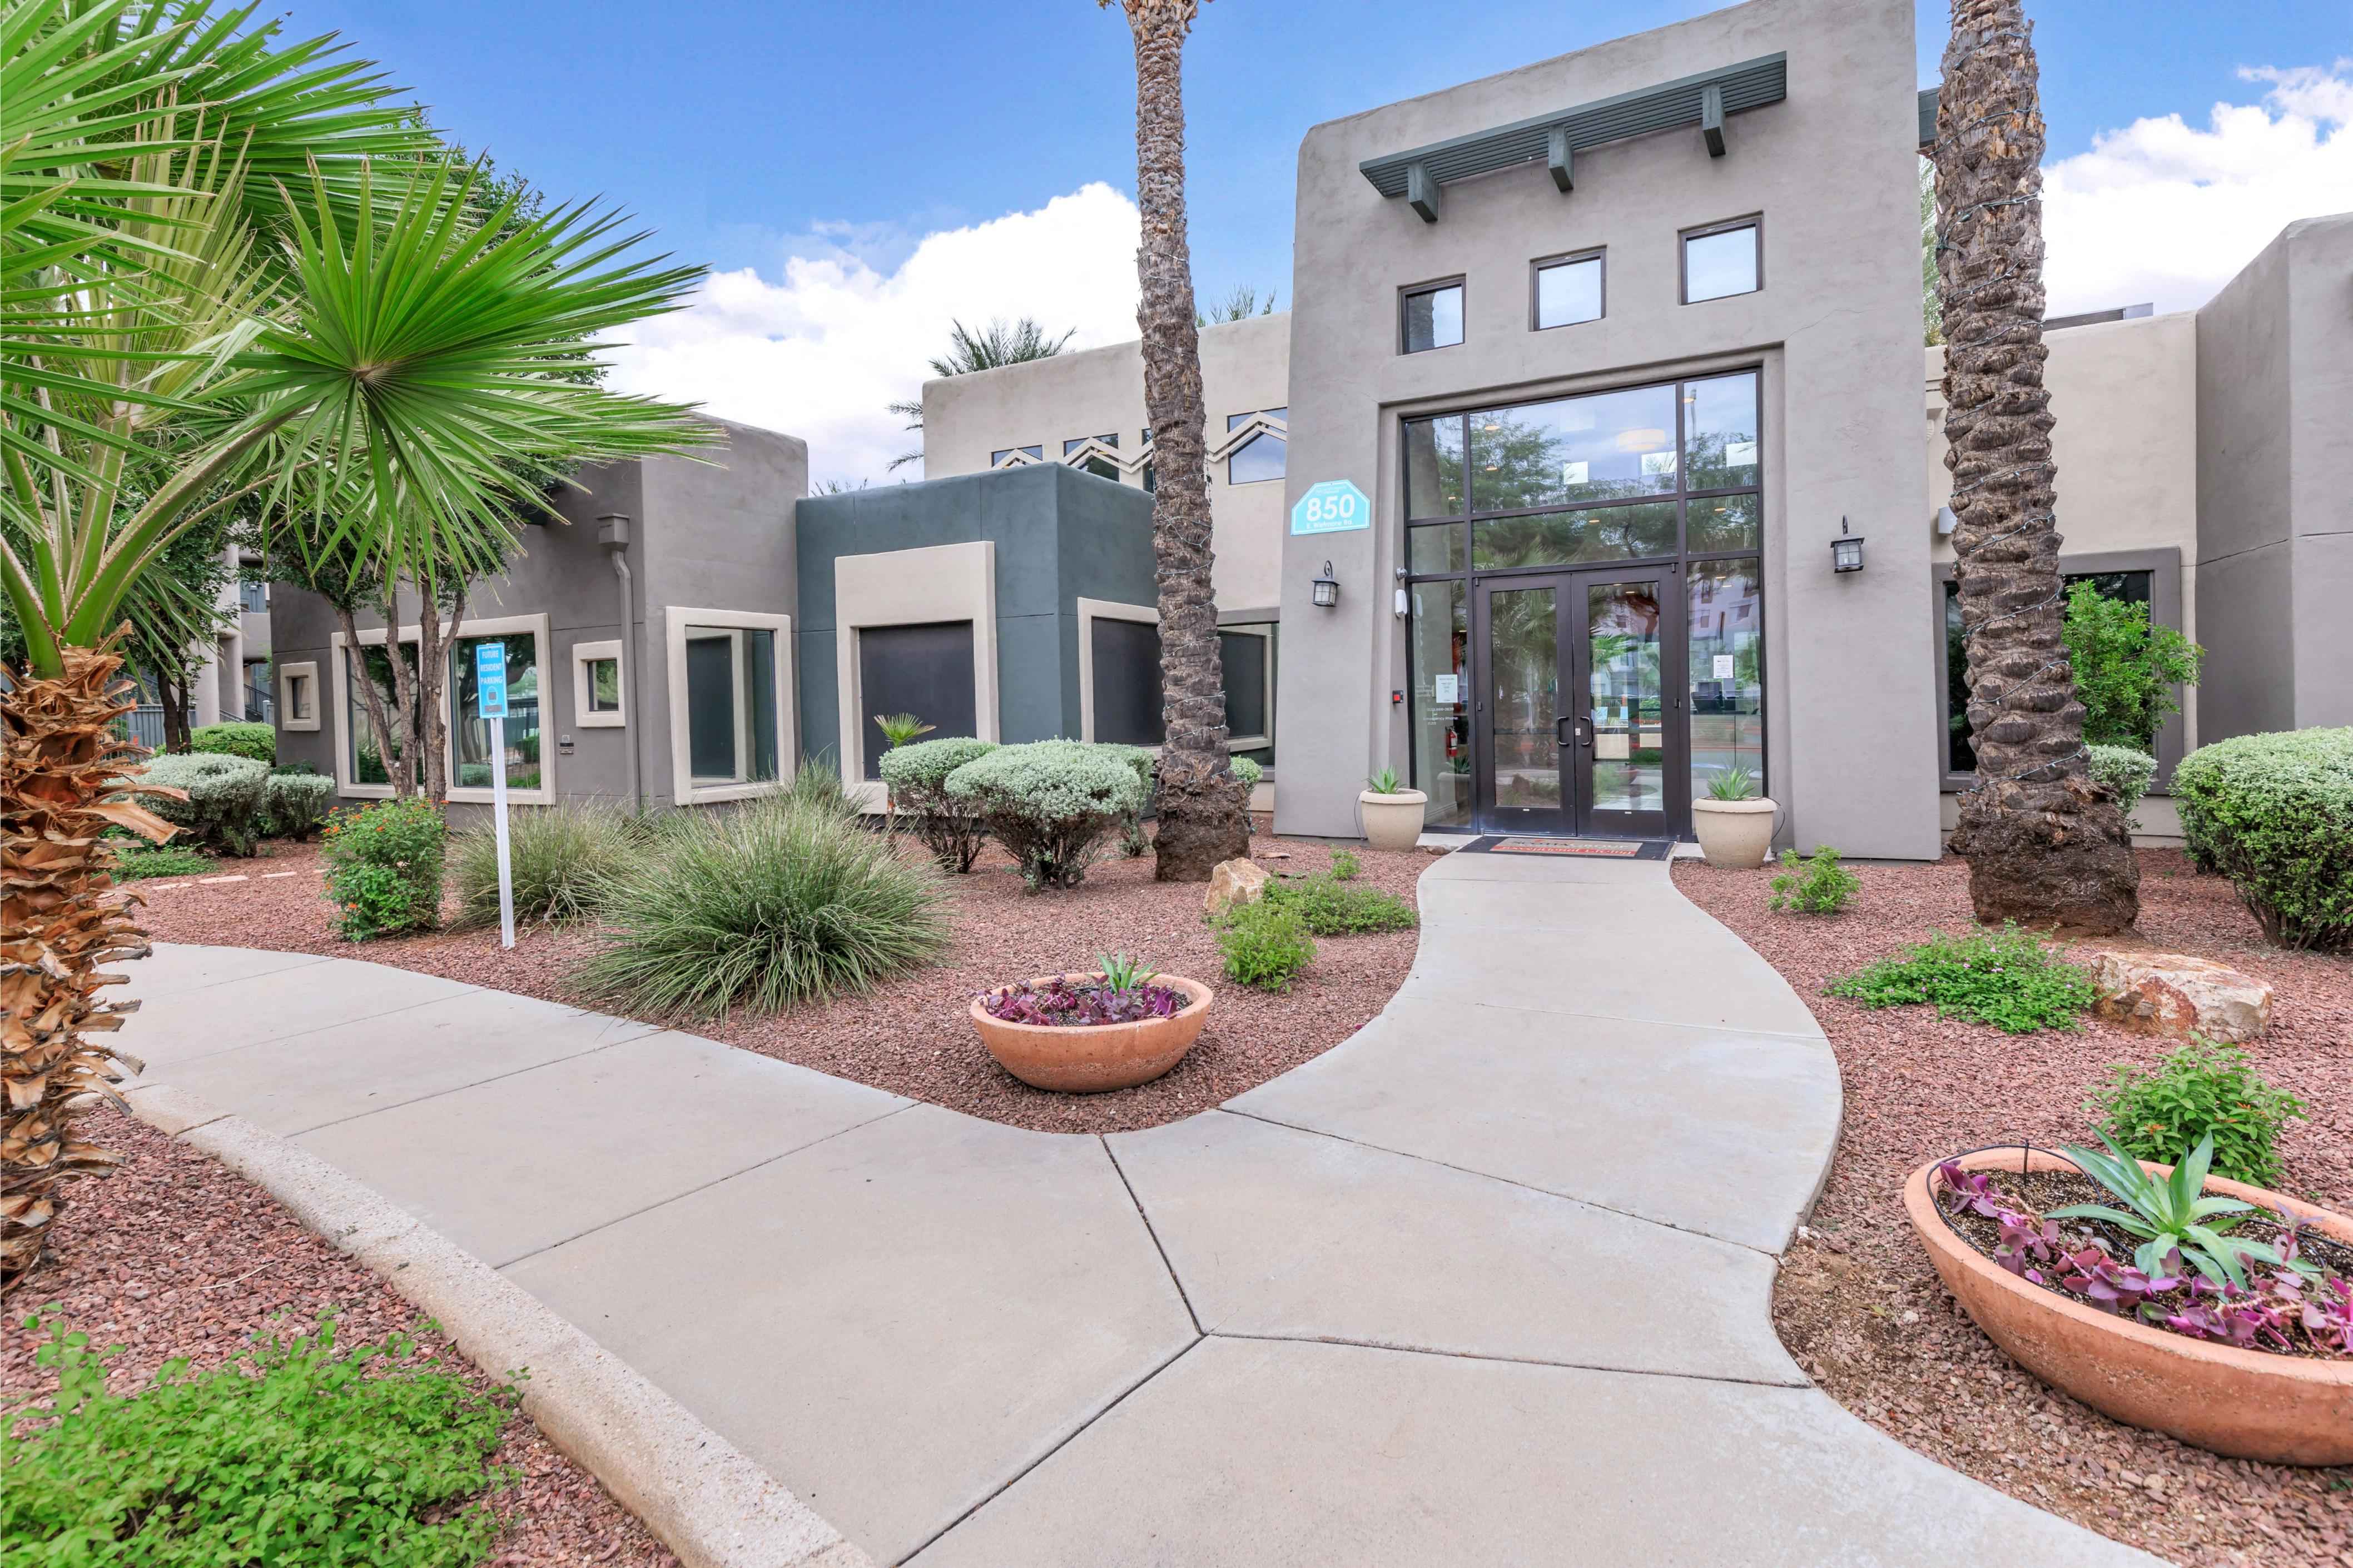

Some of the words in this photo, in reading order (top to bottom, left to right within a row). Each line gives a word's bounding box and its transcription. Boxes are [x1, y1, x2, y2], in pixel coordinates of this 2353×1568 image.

[1307, 494, 1355, 521] 850
[480, 663, 502, 671] RESIDENT
[480, 676, 503, 685] PARKING
